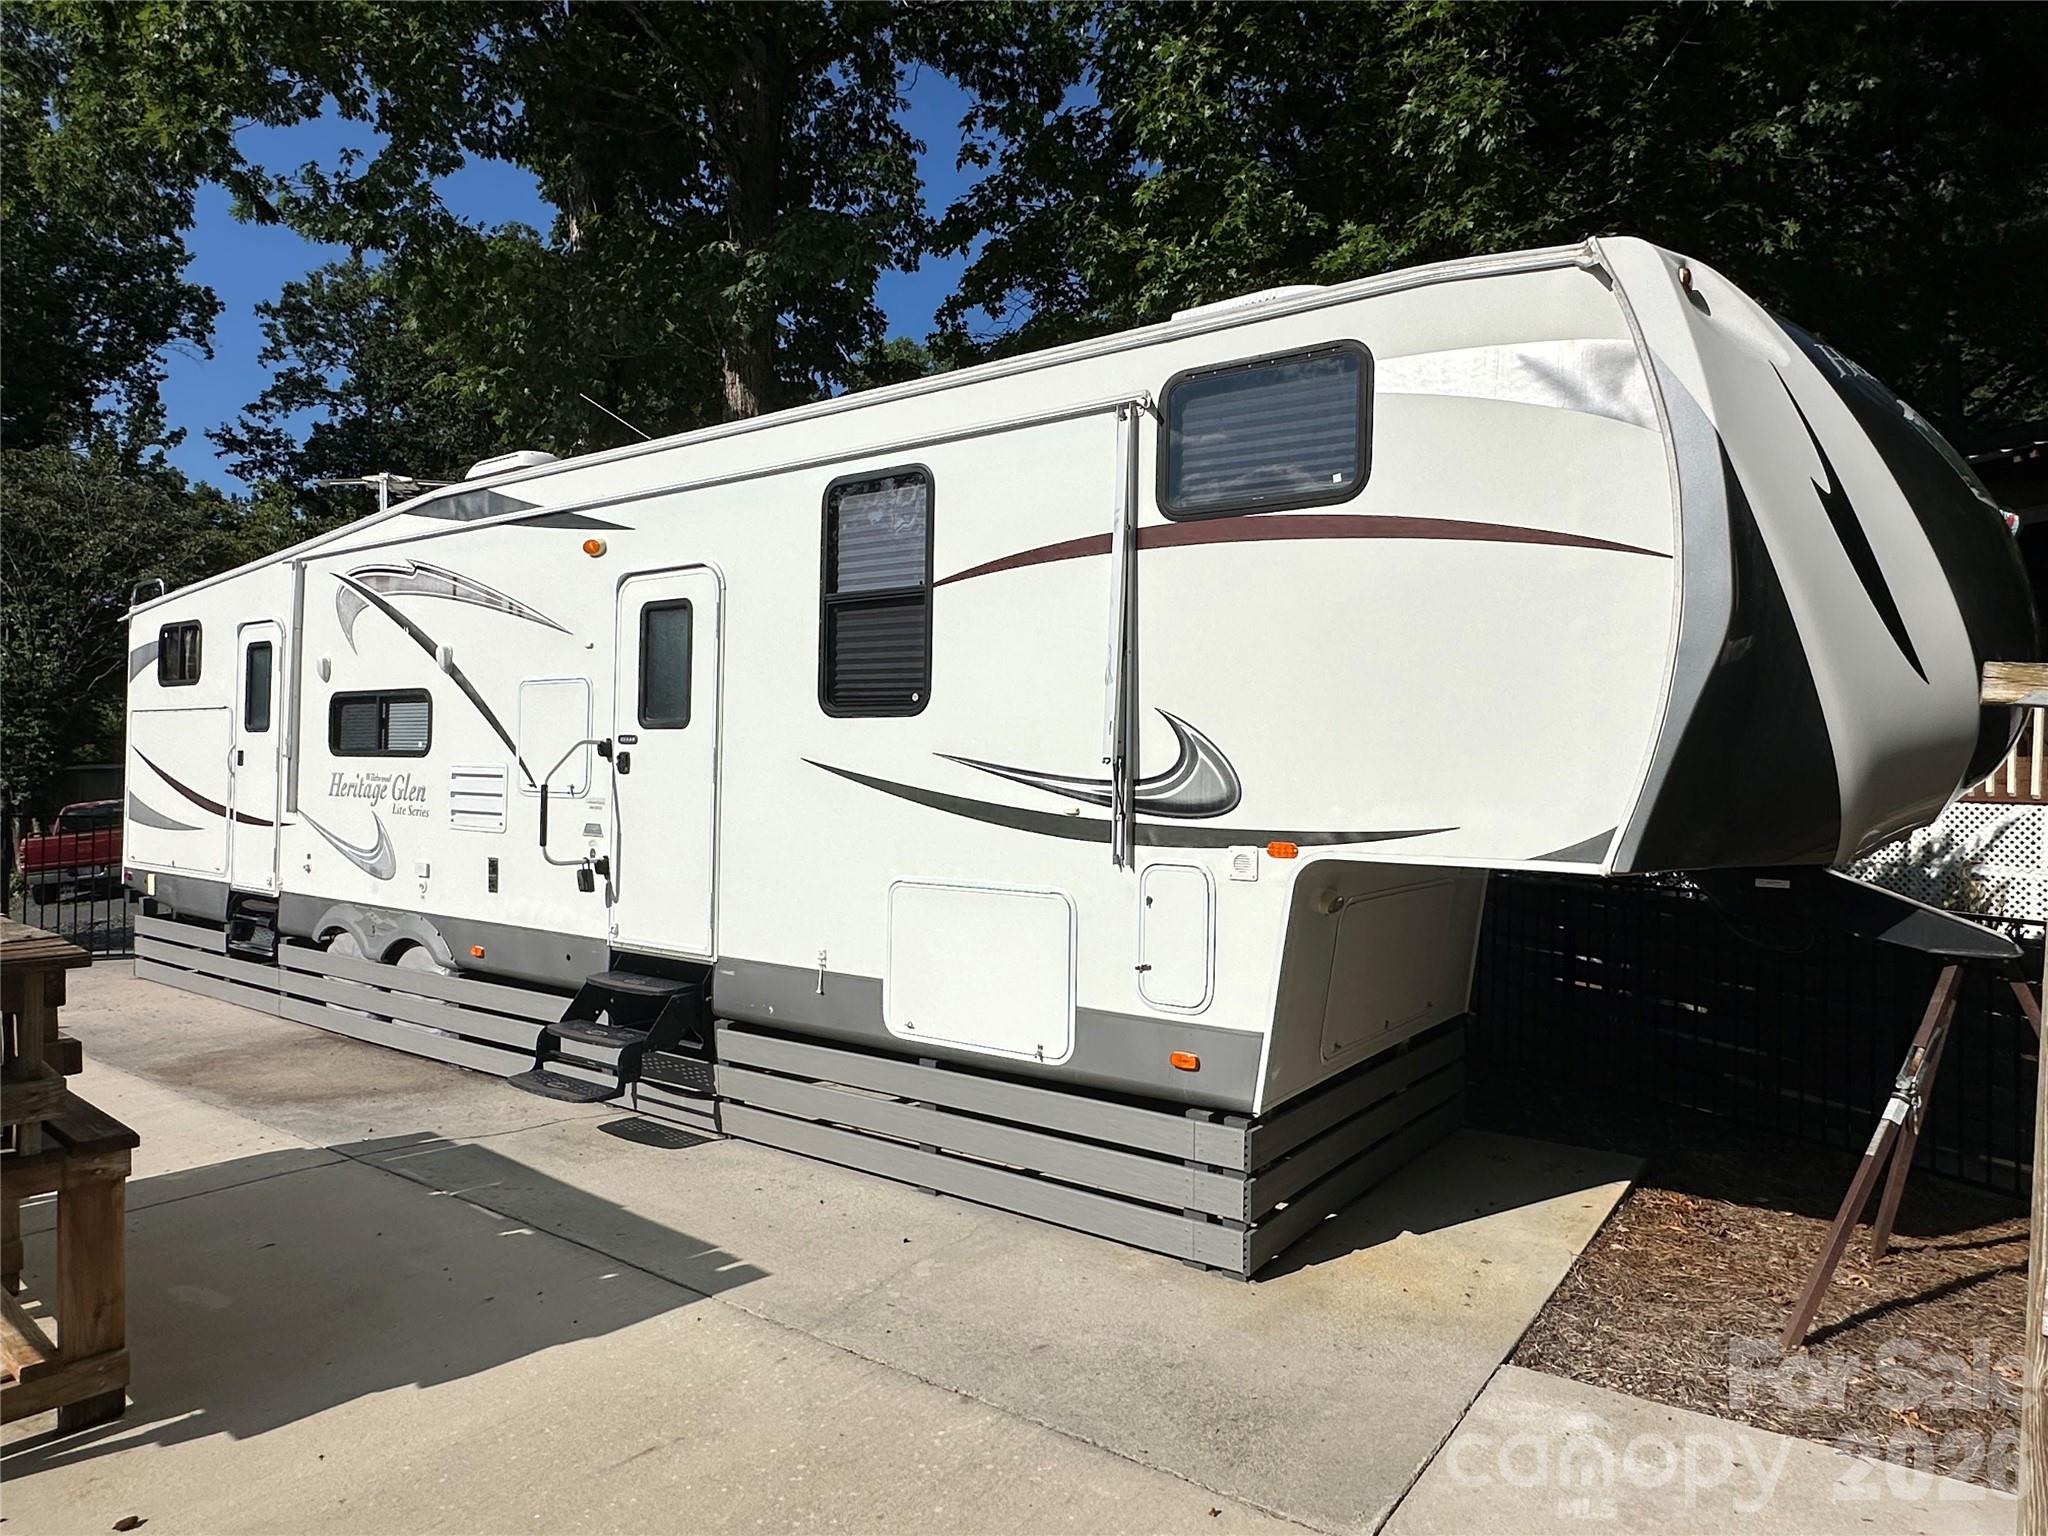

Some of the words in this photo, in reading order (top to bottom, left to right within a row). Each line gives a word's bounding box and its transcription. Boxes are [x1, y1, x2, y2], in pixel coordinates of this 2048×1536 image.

[328, 772, 388, 807] Heritage
[392, 772, 426, 802] Glen
[392, 803, 406, 815] Lite
[408, 805, 430, 818] Series
